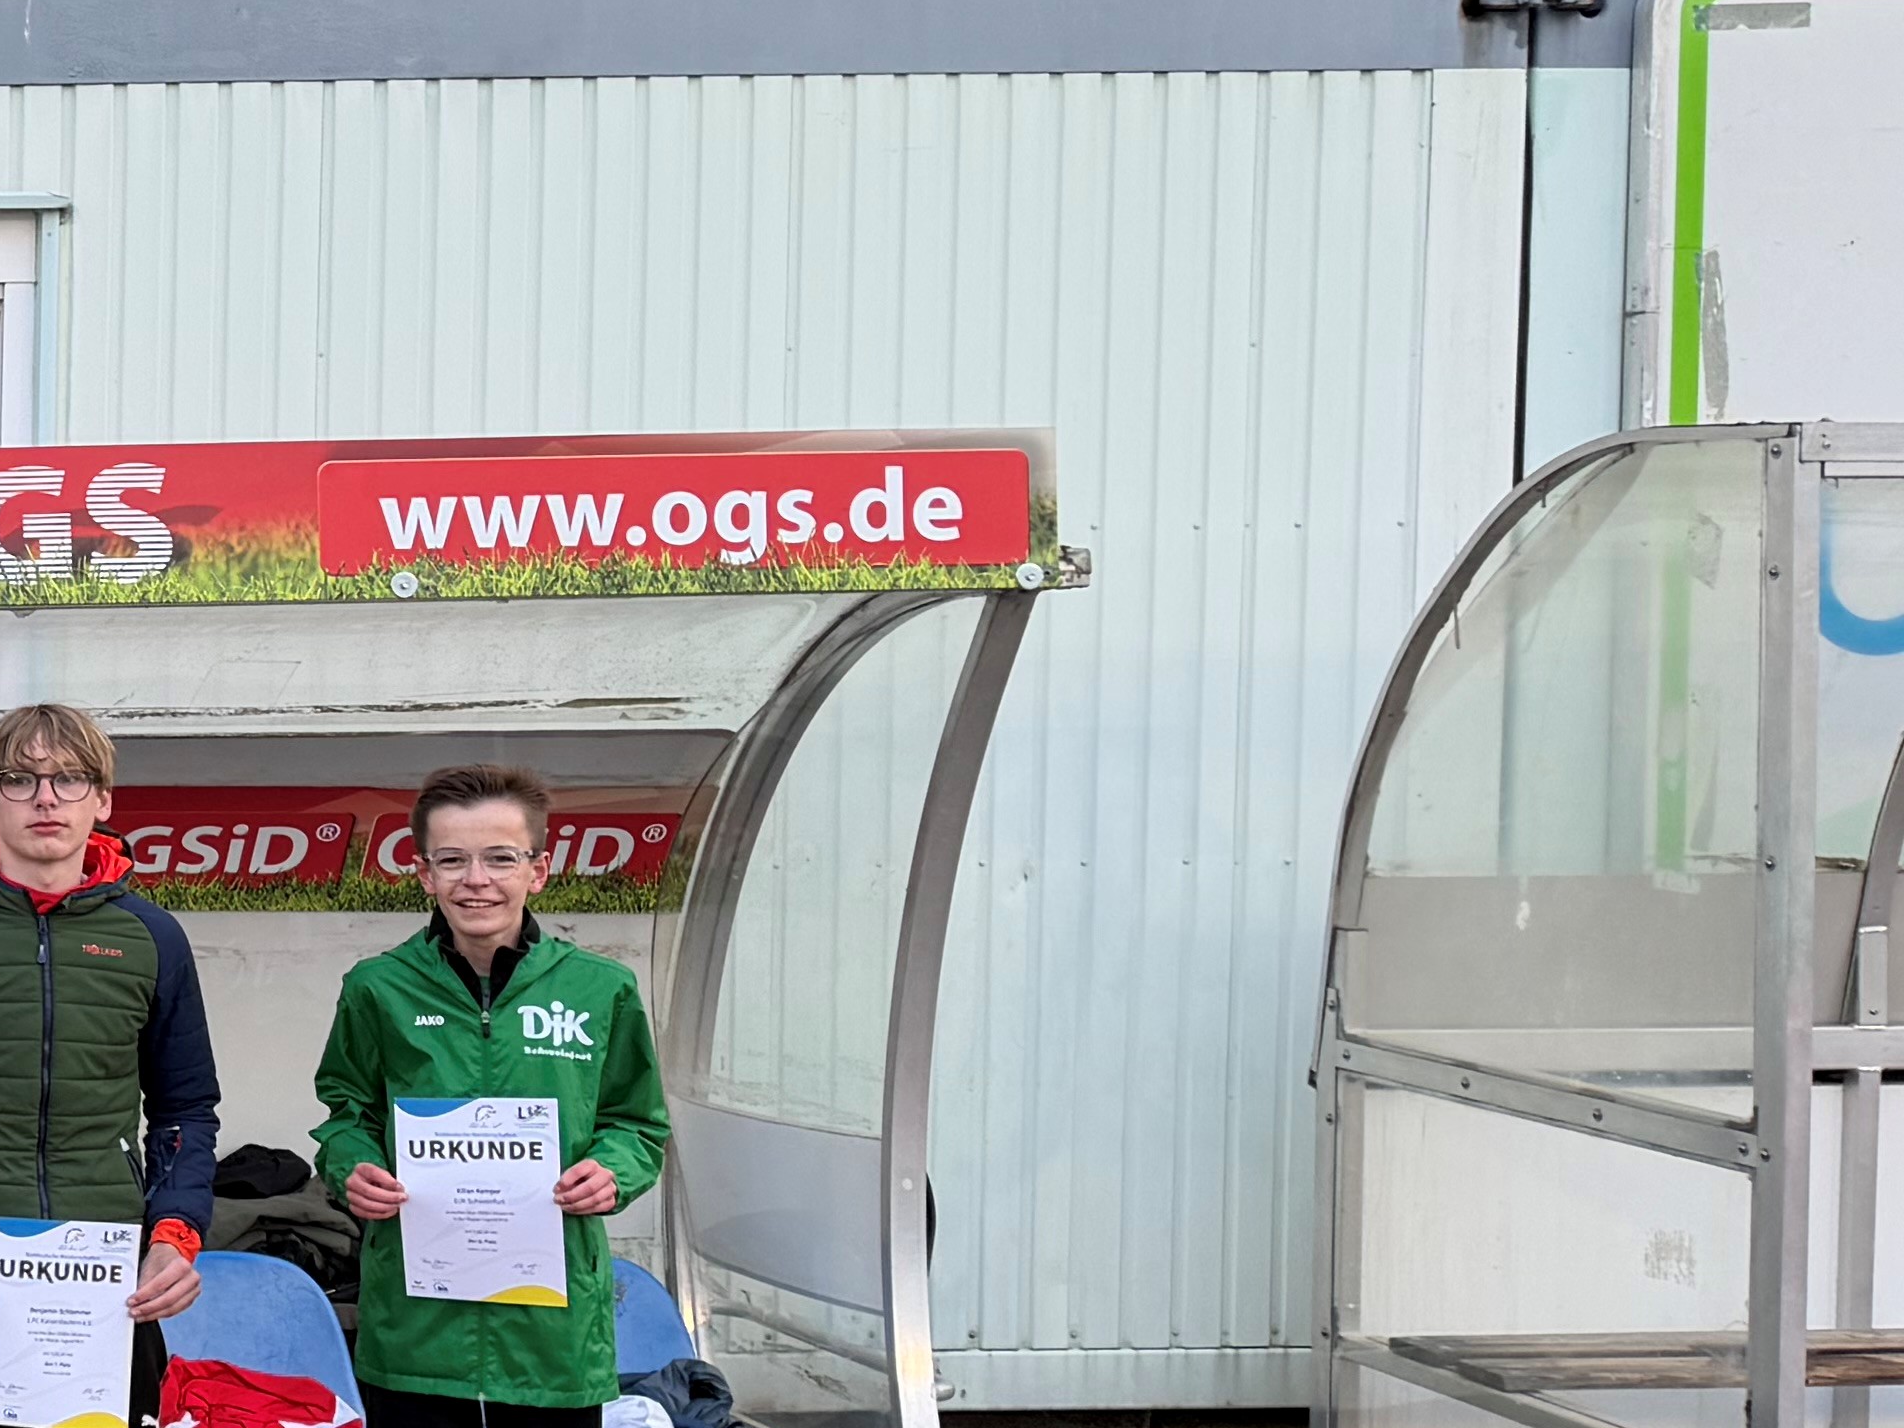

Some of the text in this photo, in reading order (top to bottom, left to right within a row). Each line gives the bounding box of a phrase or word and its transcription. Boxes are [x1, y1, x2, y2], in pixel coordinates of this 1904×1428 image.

[378, 465, 965, 565] www.ogs.de
[414, 1014, 445, 1026] JAKO
[407, 1139, 544, 1164] URKUNDE
[0, 1258, 123, 1284] URKUNDE
